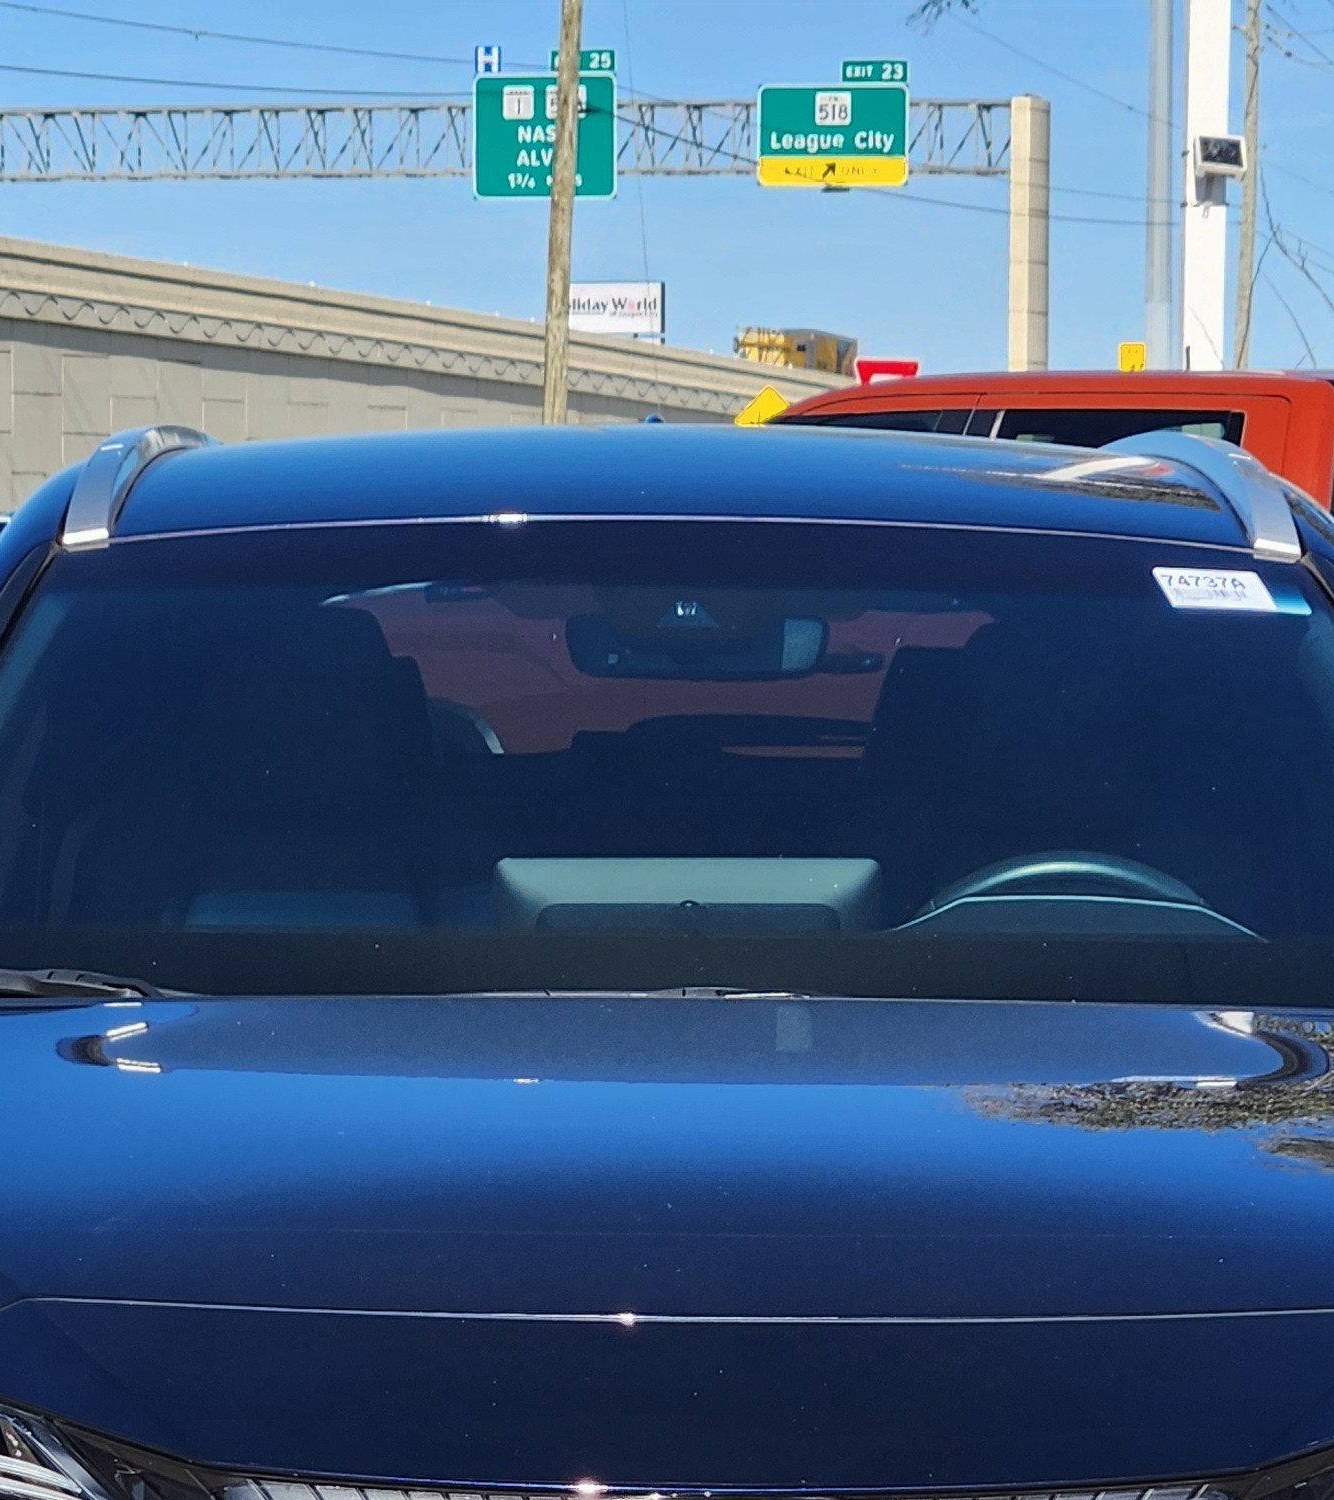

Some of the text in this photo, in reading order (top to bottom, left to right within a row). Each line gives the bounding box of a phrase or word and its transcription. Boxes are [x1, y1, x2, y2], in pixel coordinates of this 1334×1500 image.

[589, 52, 611, 68] 25
[845, 63, 904, 80] EXIT 23
[819, 103, 848, 121] 518
[517, 125, 557, 144] NAS
[770, 129, 894, 153] League City
[516, 149, 554, 167] ALV
[568, 297, 608, 313] liday
